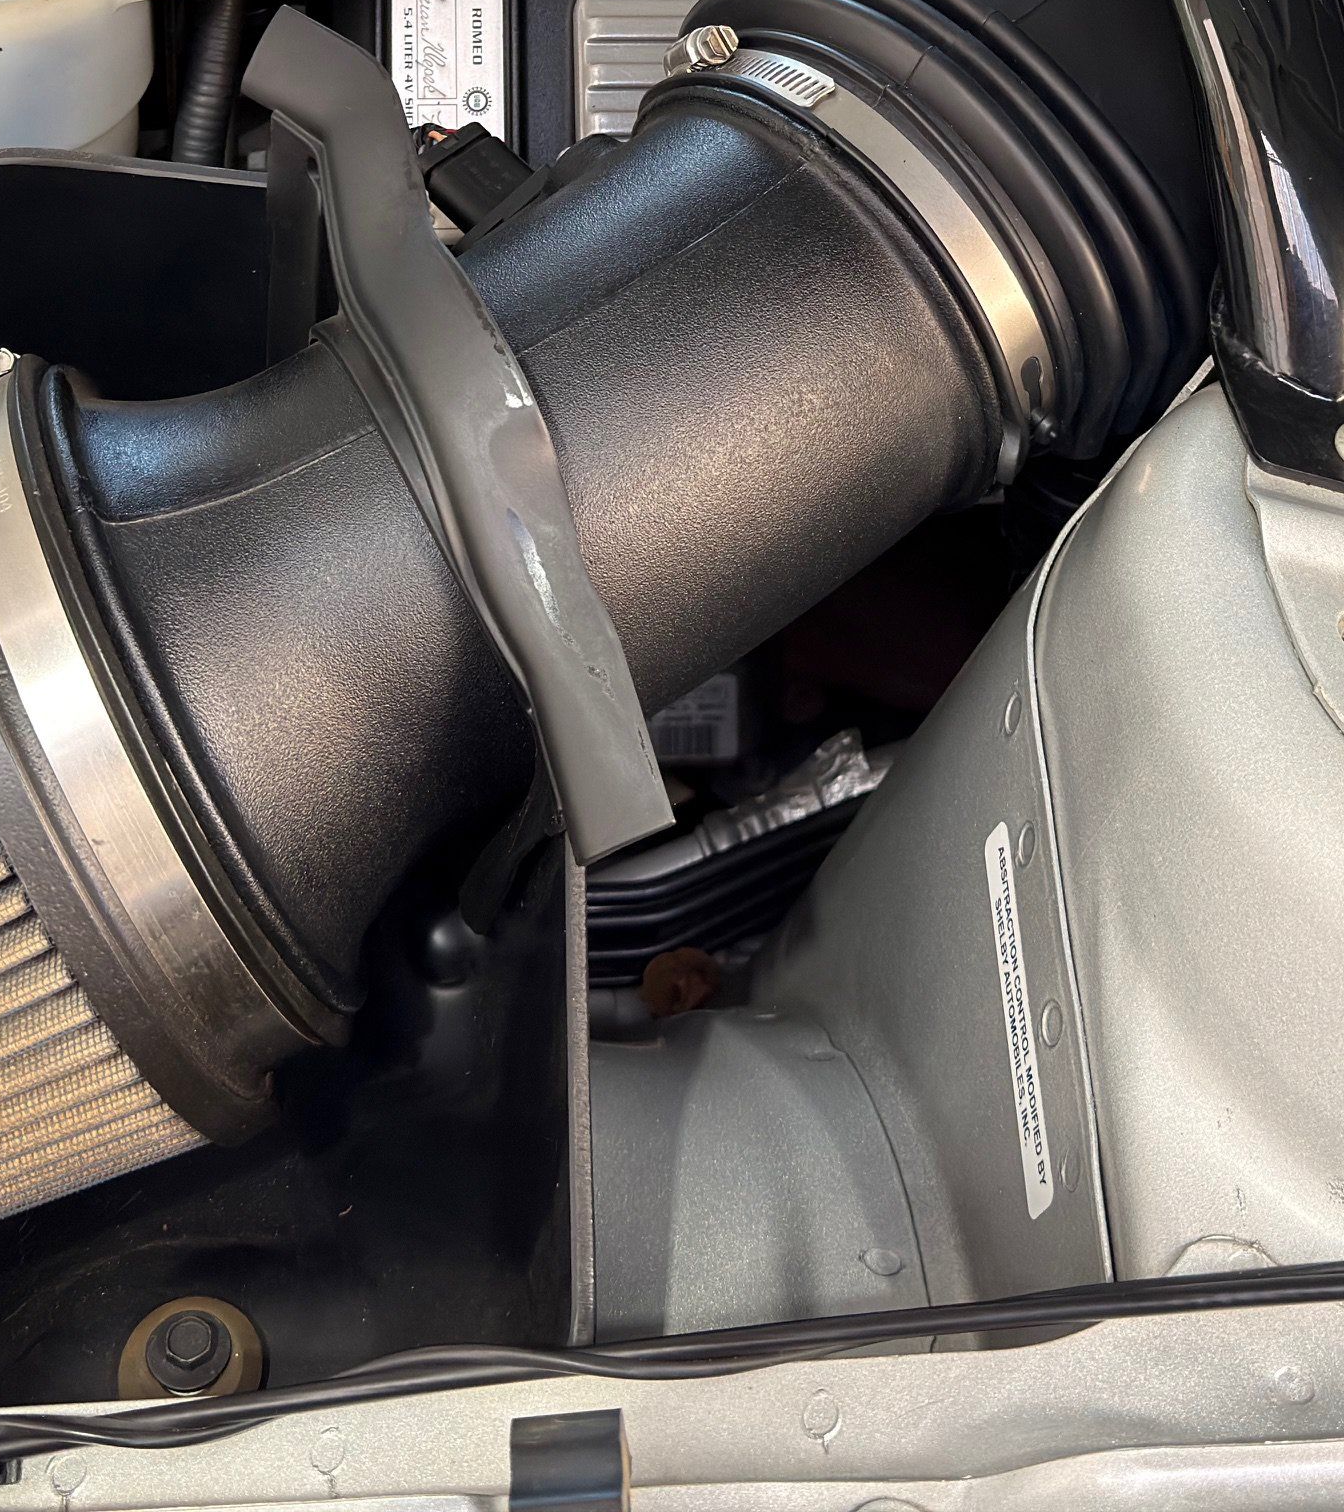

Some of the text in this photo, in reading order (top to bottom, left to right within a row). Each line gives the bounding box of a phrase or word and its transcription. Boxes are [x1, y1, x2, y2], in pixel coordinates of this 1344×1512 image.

[403, 7, 414, 29] 5.4
[471, 7, 483, 66] ROMEO
[403, 34, 414, 69] LITER
[404, 74, 414, 93] 4V
[993, 897, 1032, 1147] SHELBY AUTOMOBILES, INC.
[997, 845, 1047, 1186] ABS/TRACTION CONTROL MODIFIED BY
